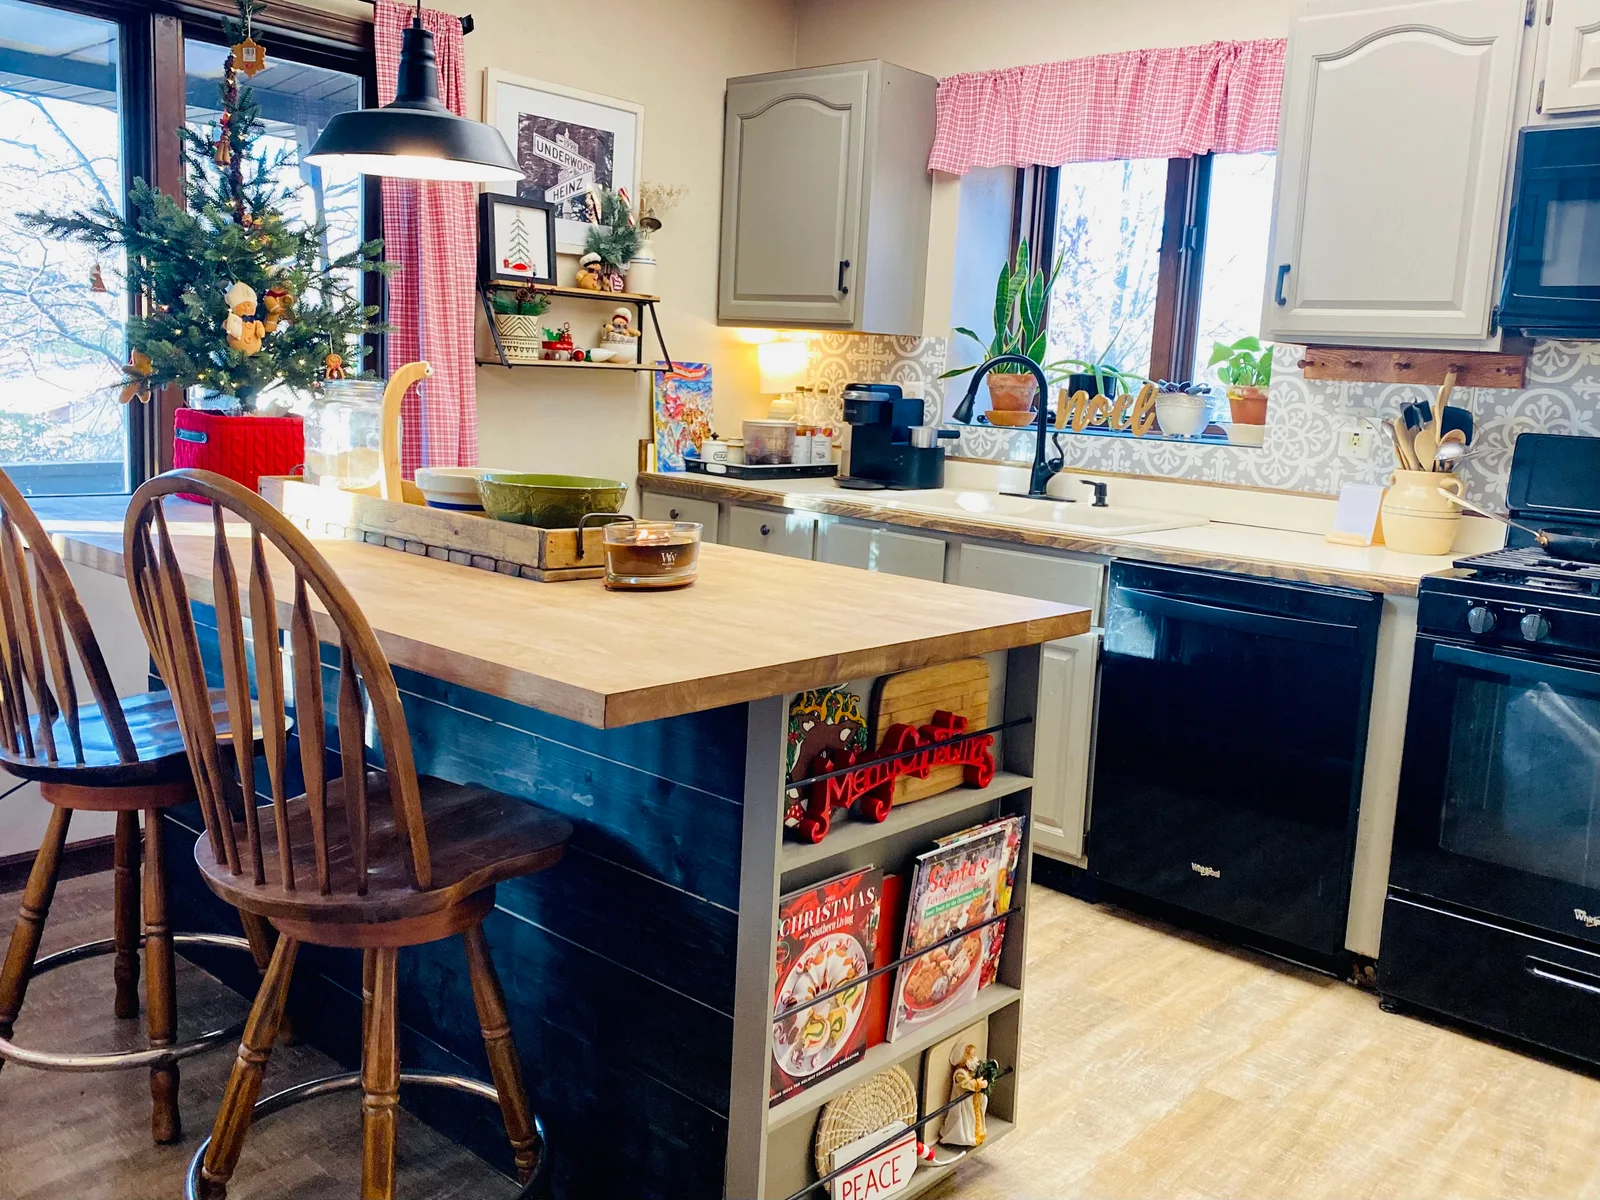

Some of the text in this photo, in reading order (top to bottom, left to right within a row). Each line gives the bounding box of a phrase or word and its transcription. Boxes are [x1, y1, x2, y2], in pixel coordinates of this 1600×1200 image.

[552, 177, 584, 202] HEINZ
[1054, 381, 1159, 438] noel
[928, 856, 990, 893] Santa's
[779, 886, 876, 938] CHRISTMAS
[809, 920, 837, 939] Southern
[836, 913, 855, 930] Living
[841, 1154, 902, 1200] PEACE
